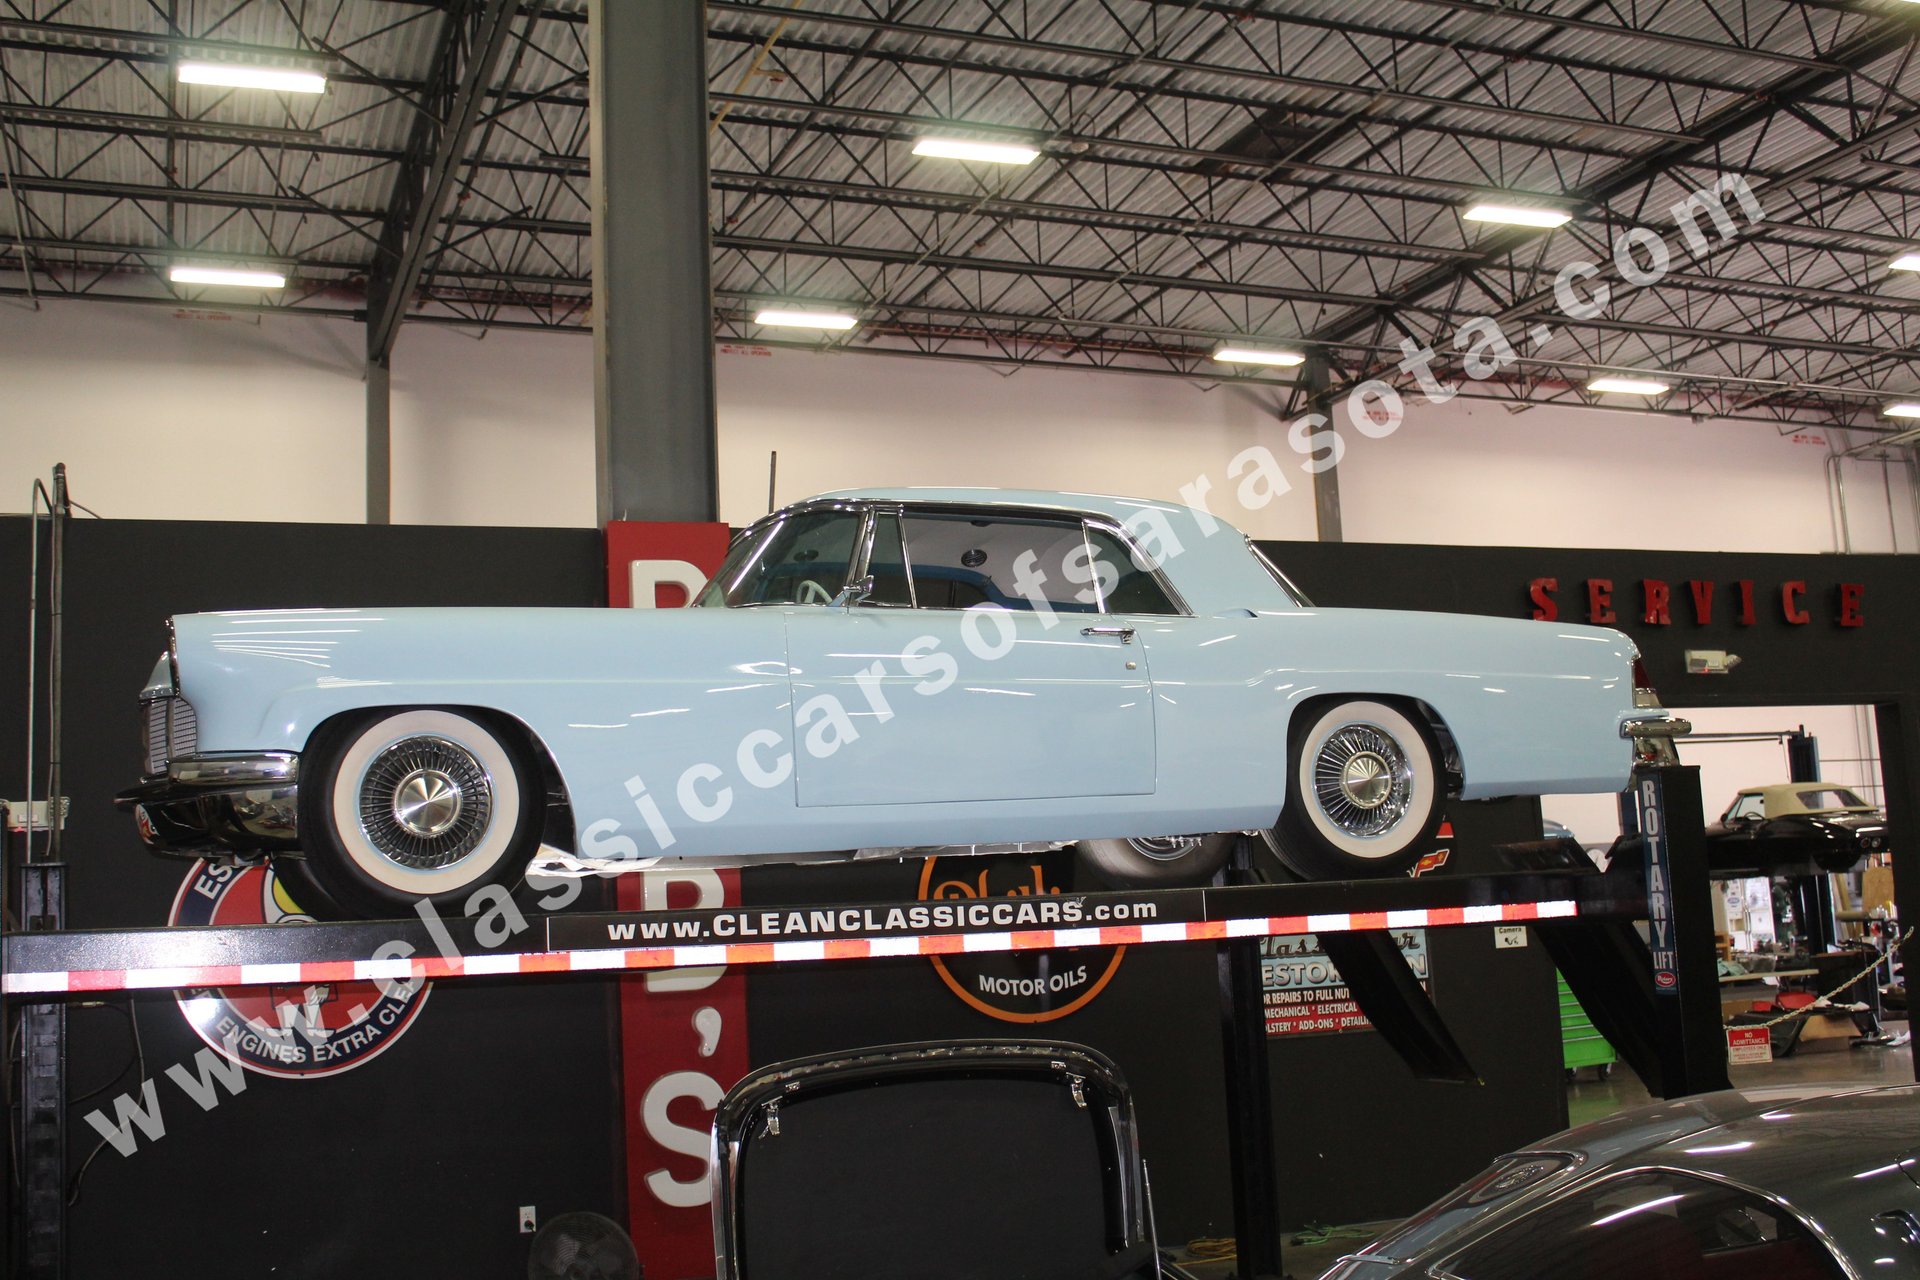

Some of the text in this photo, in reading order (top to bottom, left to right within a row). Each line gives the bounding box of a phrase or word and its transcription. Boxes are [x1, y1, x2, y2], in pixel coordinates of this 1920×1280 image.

[1529, 577, 1866, 627] SERVICE
[1642, 780, 1667, 948] ROTARY
[607, 901, 1158, 941] www.CLEANCLASSICCARS.com
[1653, 951, 1674, 970] LIFT
[978, 966, 1087, 996] MOTOR OILS
[1272, 990, 1302, 1004] REPAIRS
[1303, 989, 1314, 1001] TO
[1315, 988, 1333, 1001] FULL
[1264, 1002, 1357, 1019] MECHANICAL ELECTRICAL
[1298, 1017, 1334, 1031] ADD-ONS
[216, 1015, 306, 1062] ENGINES
[313, 1024, 381, 1062] EXTRA
[1733, 1038, 1766, 1046] ADMITTANCE
